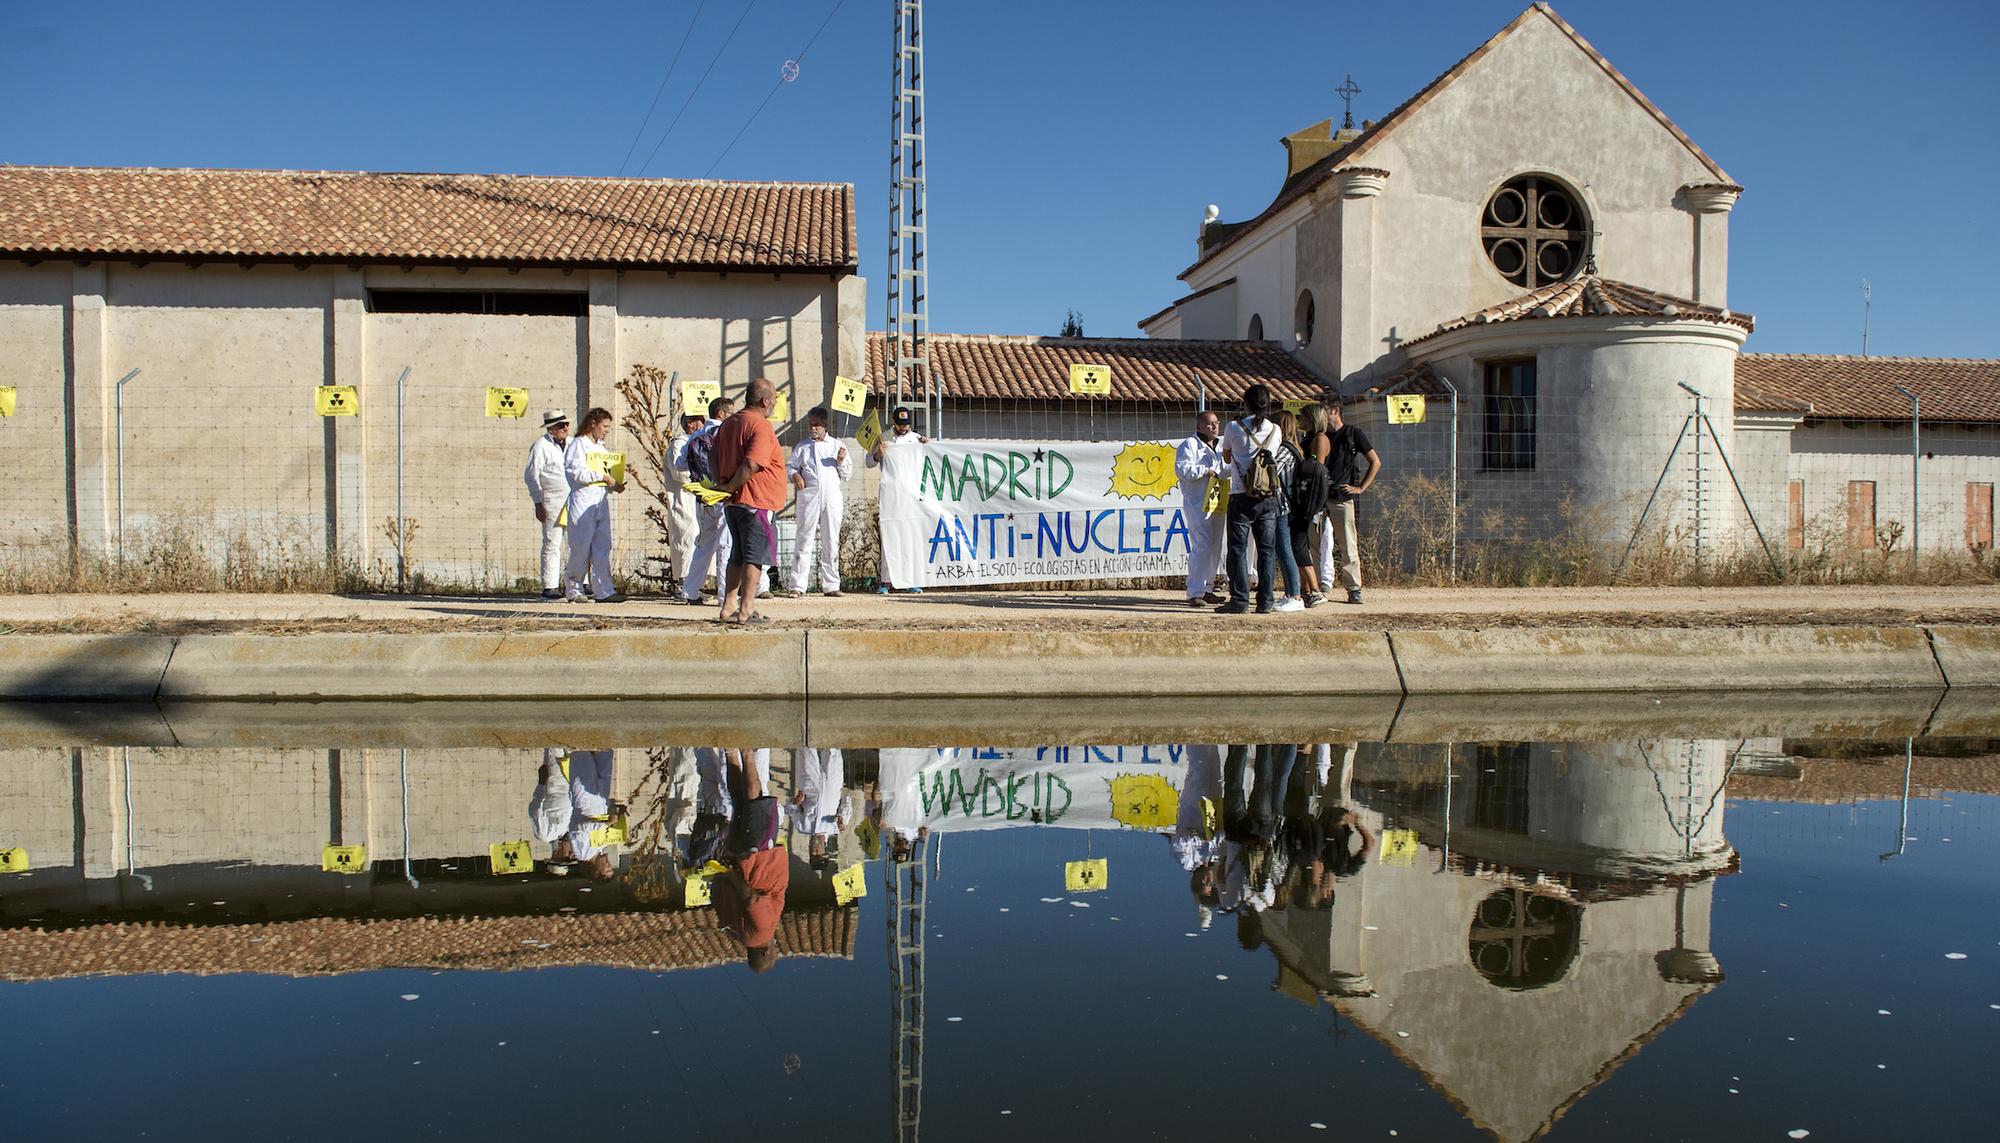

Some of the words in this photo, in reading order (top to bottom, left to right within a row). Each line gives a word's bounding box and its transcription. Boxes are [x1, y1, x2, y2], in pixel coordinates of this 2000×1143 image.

[919, 448, 1074, 502] MADRiD
[928, 508, 1192, 564] ANTi-NUCLEA
[936, 563, 974, 579] ARBA
[1024, 559, 1087, 577] ECOLOGiSTAS
[1089, 559, 1100, 574] EN
